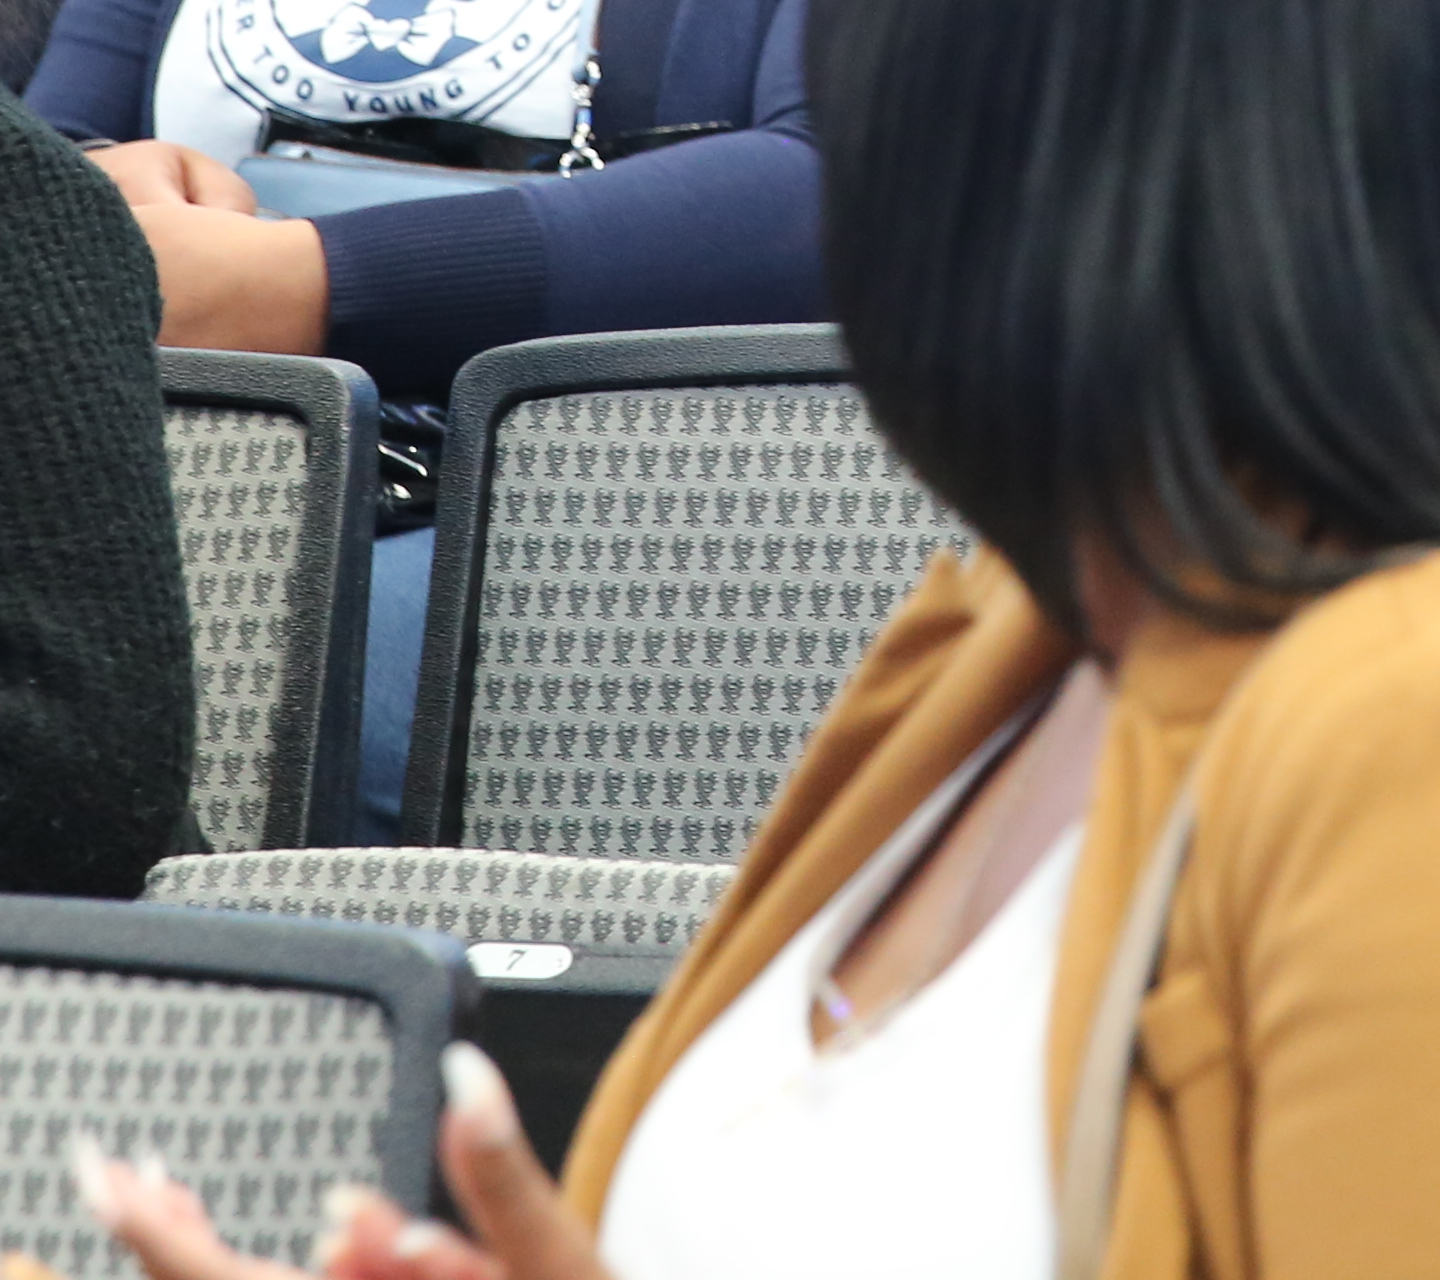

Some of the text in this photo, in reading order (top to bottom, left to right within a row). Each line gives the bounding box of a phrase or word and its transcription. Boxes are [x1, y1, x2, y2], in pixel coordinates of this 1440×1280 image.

[252, 43, 315, 102] TOO
[342, 78, 466, 115] YOUNG
[482, 32, 531, 71] TO
[506, 949, 529, 972] 7
